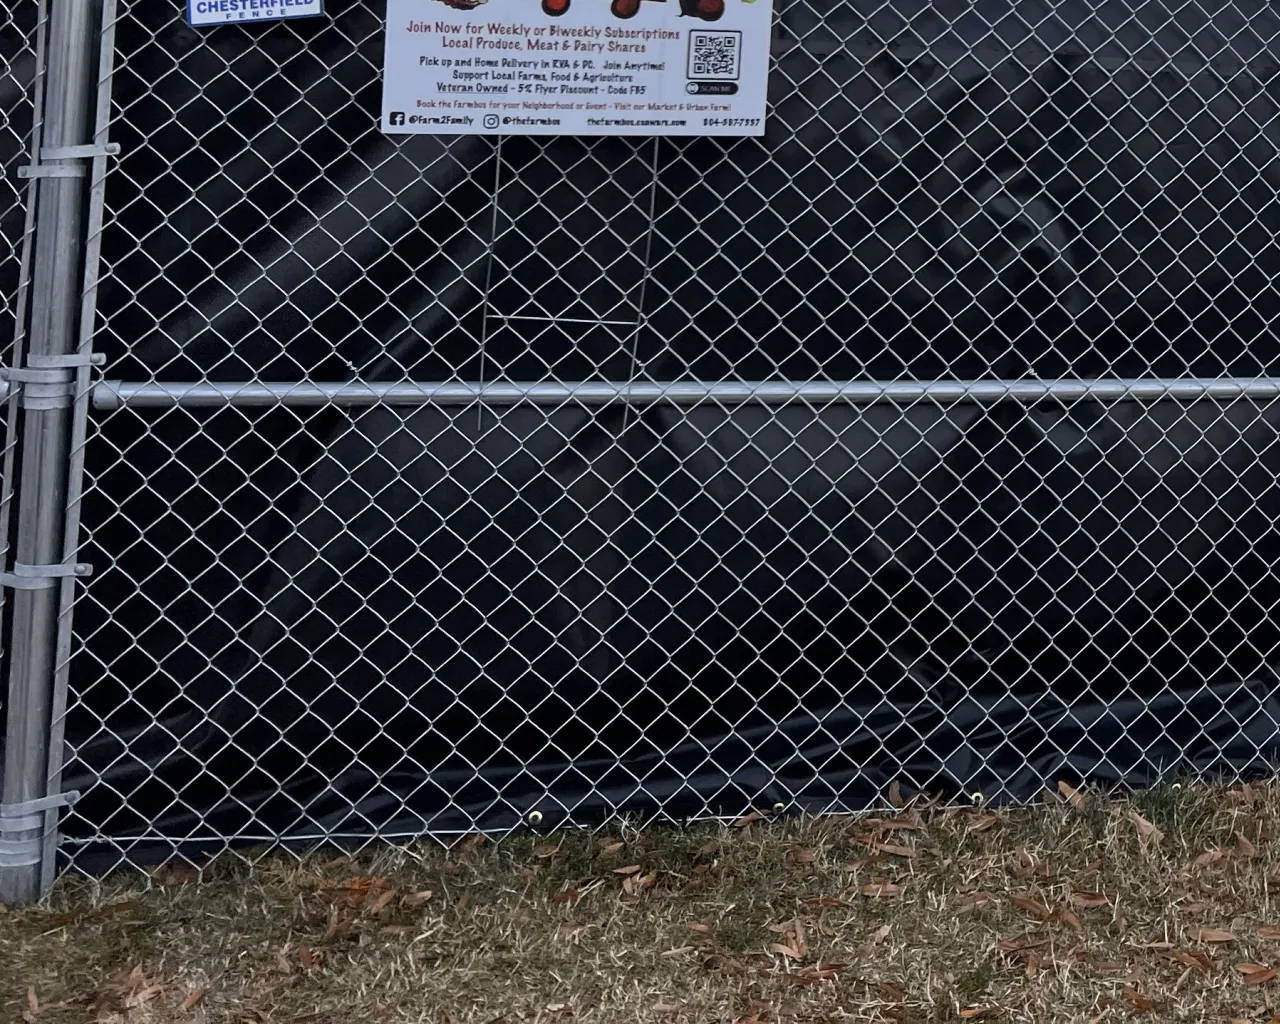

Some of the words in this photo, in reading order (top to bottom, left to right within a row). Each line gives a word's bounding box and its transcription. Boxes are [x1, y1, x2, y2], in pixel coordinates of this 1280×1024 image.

[226, 8, 287, 20] FENCE
[407, 21, 431, 33] Join
[435, 22, 462, 34] Now
[465, 22, 484, 34] for
[487, 23, 531, 37] Weekly
[533, 27, 547, 36] or
[550, 25, 601, 39] Biweekly
[604, 26, 680, 41] Subscriptions
[442, 36, 472, 49] Local
[476, 37, 523, 51] Produce,
[527, 39, 559, 51] Meat
[562, 40, 571, 51] &
[574, 40, 604, 53] Dairy
[608, 41, 646, 53] Shares
[420, 56, 439, 66] Pick
[441, 58, 452, 68] up
[454, 58, 472, 67] and
[474, 57, 499, 67] Home
[501, 58, 539, 69] Delivery
[541, 60, 550, 68] in
[552, 60, 570, 69] RVA
[603, 60, 621, 70] Join
[624, 62, 665, 72] Anytime!
[453, 70, 489, 80] Support
[491, 70, 516, 80] Local
[550, 72, 571, 82] Food
[582, 72, 633, 83] Agriculture
[436, 82, 473, 93] Veteran
[476, 83, 508, 93] Owned
[517, 84, 532, 93] 5%
[534, 84, 557, 95] Flyer
[560, 84, 598, 94] Discount
[607, 86, 627, 94] Code
[416, 100, 436, 108] Book
[438, 100, 451, 108] the
[453, 100, 486, 109] Farmbus
[489, 101, 500, 109] for
[522, 102, 574, 110] Neighborhood
